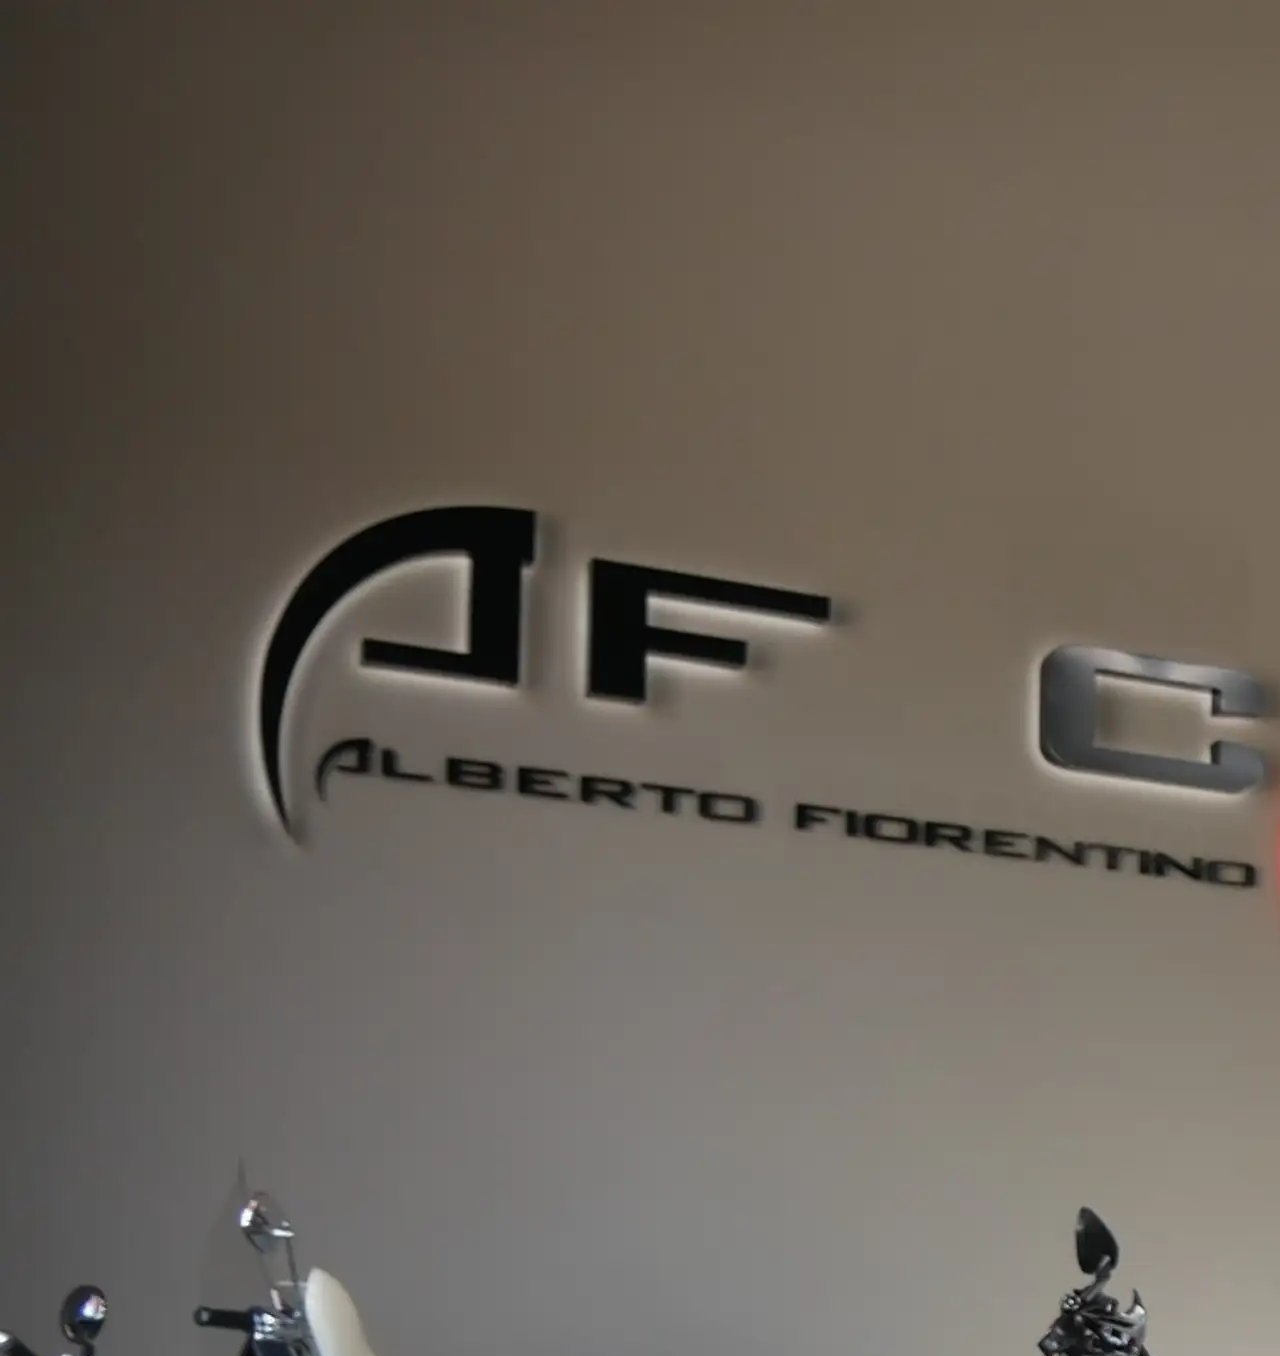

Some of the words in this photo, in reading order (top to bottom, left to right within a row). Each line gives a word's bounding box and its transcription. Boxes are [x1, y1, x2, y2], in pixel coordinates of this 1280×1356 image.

[258, 505, 832, 845] AF
[315, 736, 760, 826] ALBERTO
[795, 803, 1257, 889] FIORENTINO
